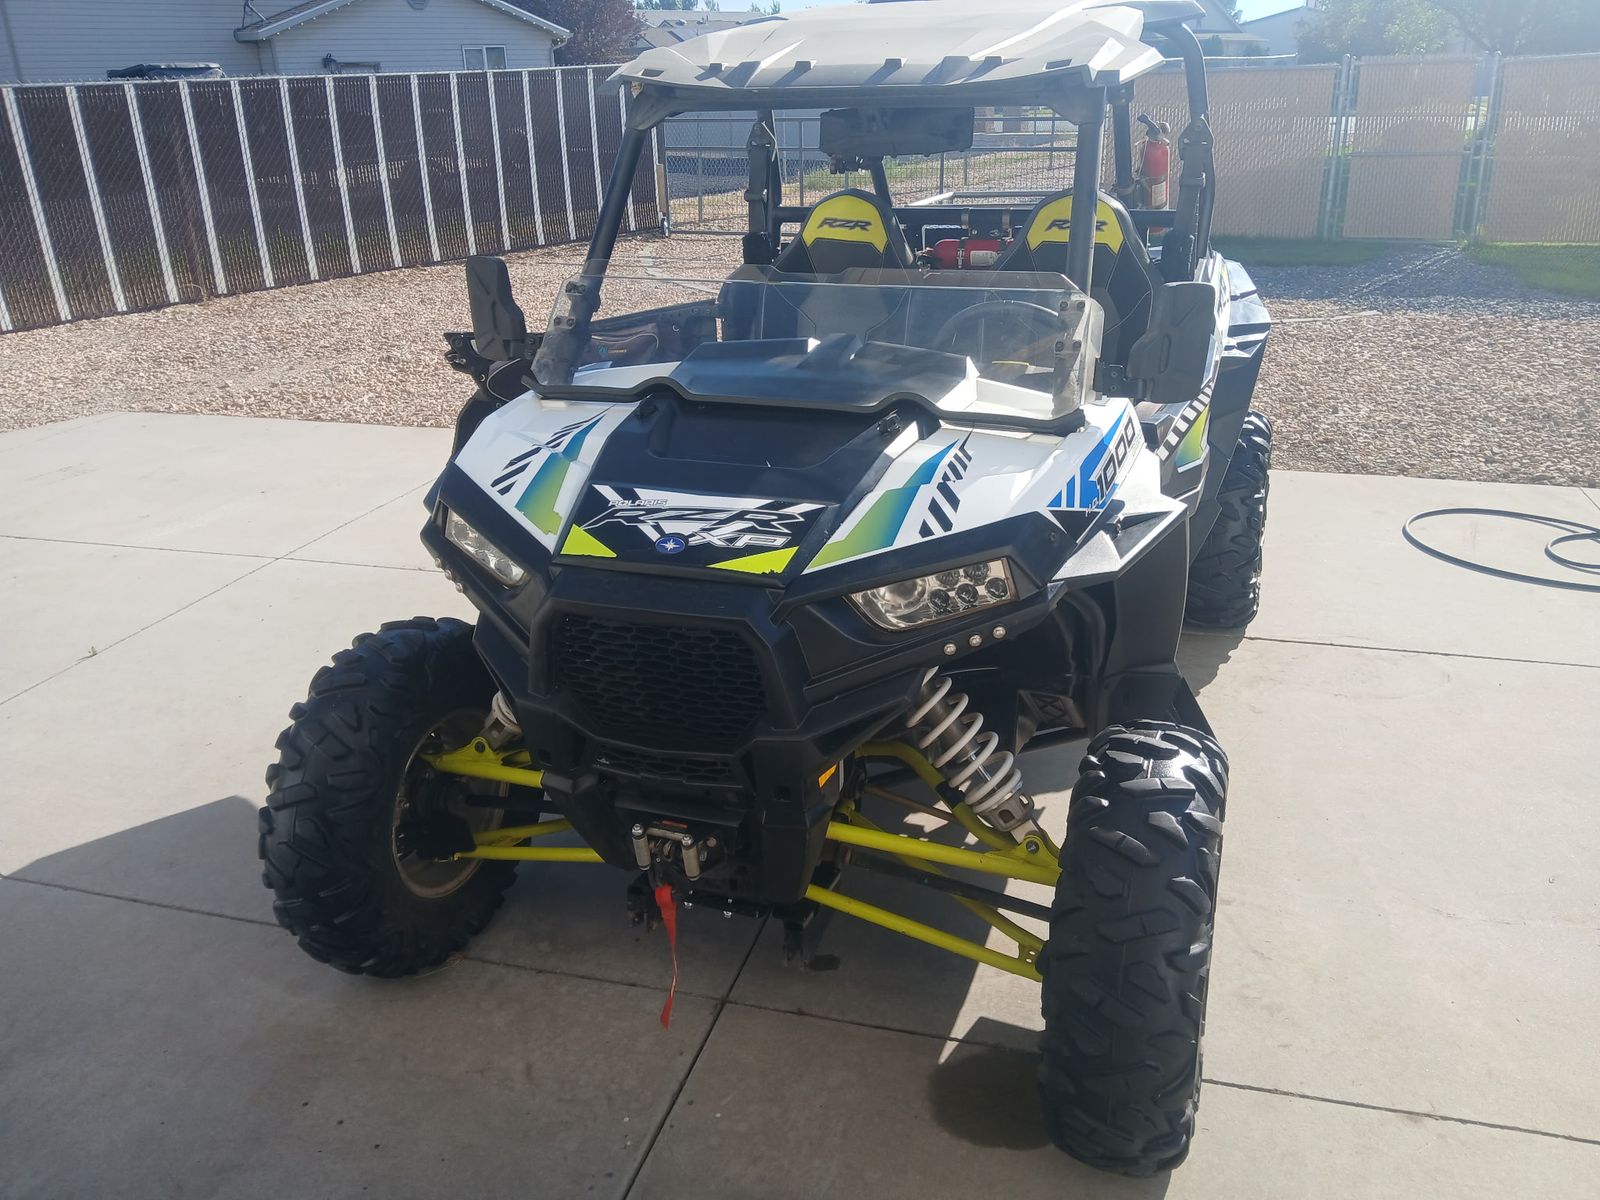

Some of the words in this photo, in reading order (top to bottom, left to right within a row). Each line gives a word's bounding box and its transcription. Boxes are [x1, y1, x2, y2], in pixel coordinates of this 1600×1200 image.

[817, 217, 873, 232] RZR
[1095, 415, 1136, 502] 1000
[607, 499, 668, 508] POLARIS
[580, 507, 805, 533] RZR
[688, 531, 792, 549] XP
